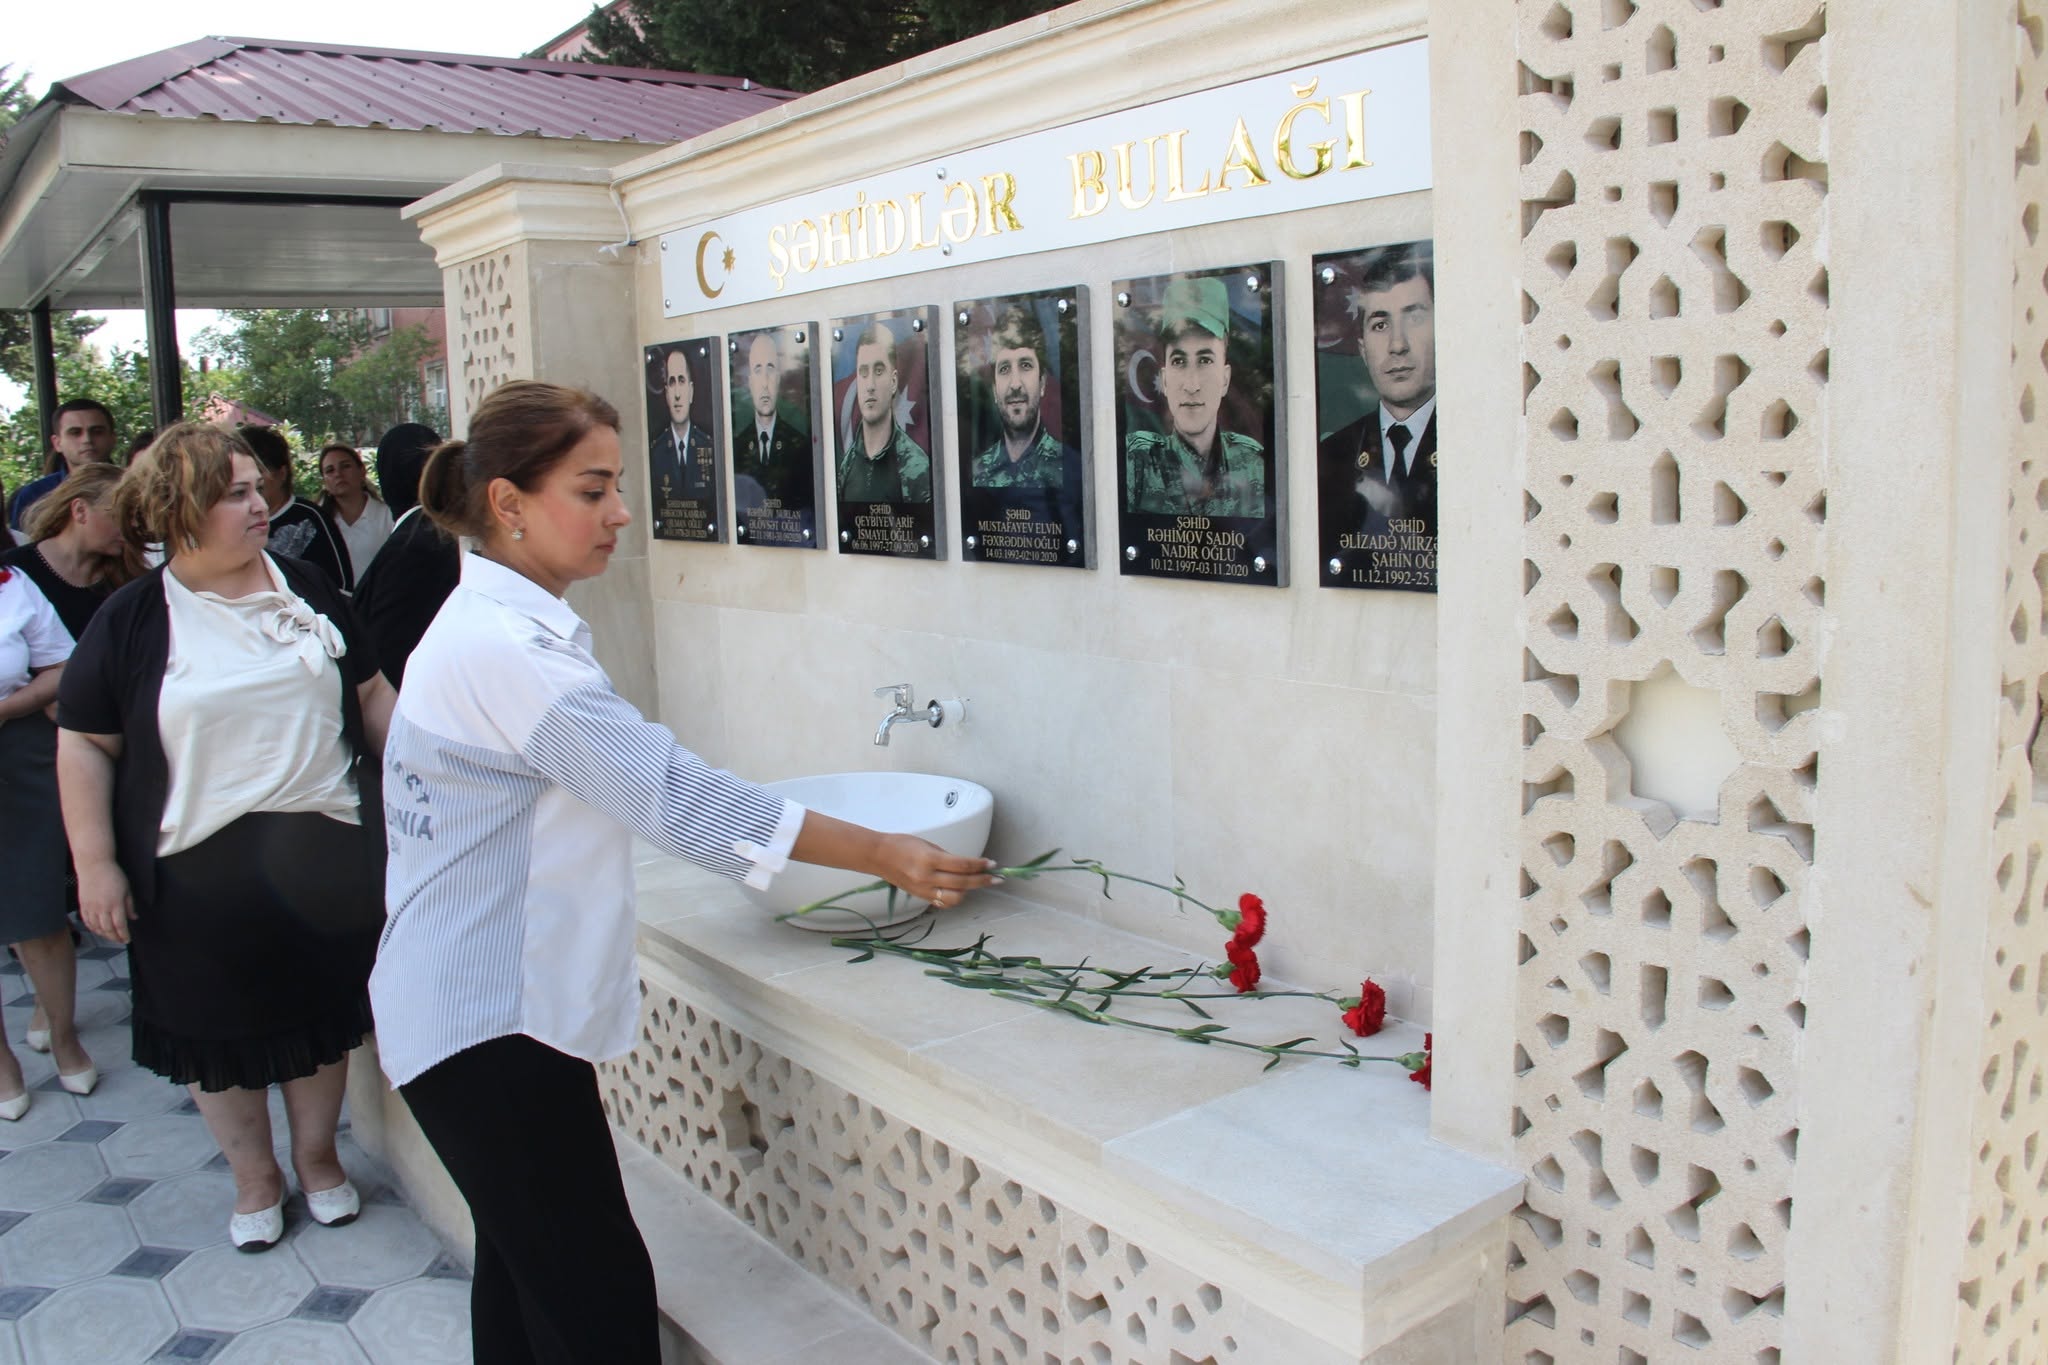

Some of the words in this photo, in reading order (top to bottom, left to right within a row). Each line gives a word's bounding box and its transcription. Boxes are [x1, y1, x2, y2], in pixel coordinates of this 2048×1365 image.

[767, 171, 1025, 292] ŞƏHİDLƏR
[1064, 75, 1375, 220] BULAĞI
[869, 503, 891, 516] ŞƏHİD
[1005, 507, 1032, 522] ŞƏHİD
[895, 514, 915, 529] ARİF
[977, 519, 1034, 534] MUSTAFAYEV
[1035, 521, 1063, 535] ELVİN
[1176, 514, 1210, 531] ŞƏHİD
[1387, 517, 1425, 537] ŞƏHİD
[889, 528, 914, 542] OĞLU
[981, 534, 1033, 549] FƏXRƏDDİN
[1034, 535, 1061, 550] OĞLU
[1147, 527, 1203, 544] RƏHİMOV
[1206, 530, 1246, 550] SADİQ
[1339, 531, 1397, 550] ƏLİZADƏ
[1161, 543, 1199, 559] NADİR
[1201, 545, 1236, 562] OĞLU
[1371, 550, 1412, 570] ŞAHİN
[1414, 551, 1438, 570] OĞ
[1150, 558, 1249, 577] 10.12.1997-03.11.2020
